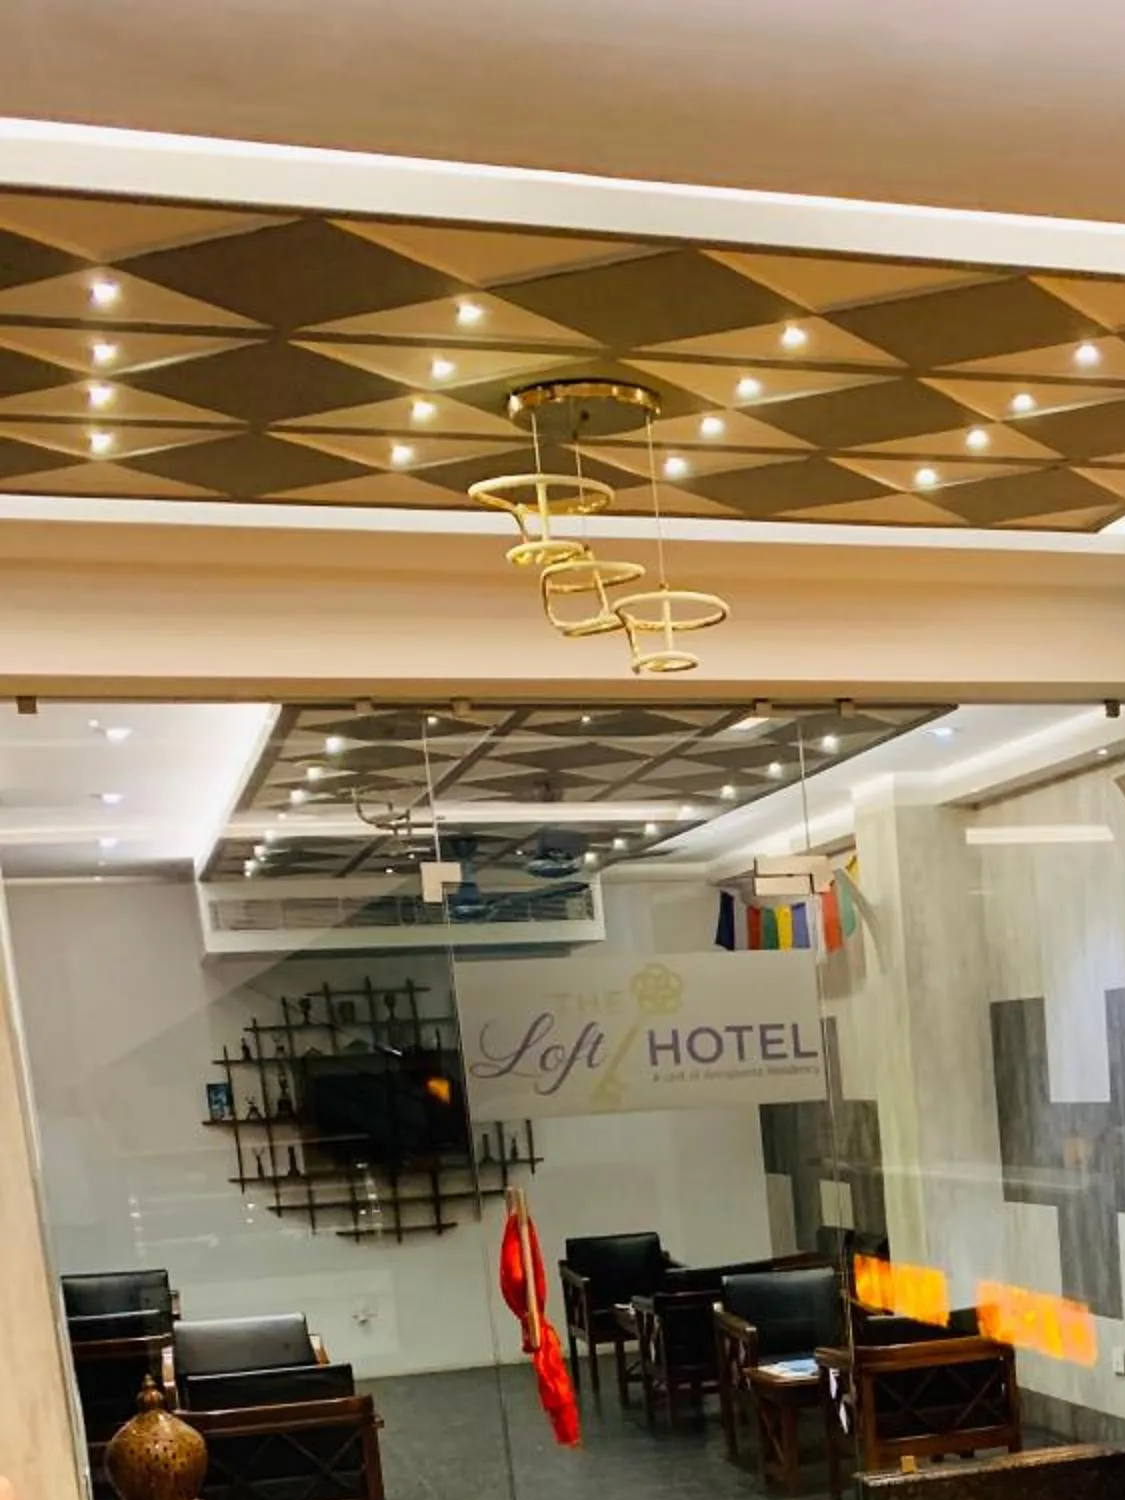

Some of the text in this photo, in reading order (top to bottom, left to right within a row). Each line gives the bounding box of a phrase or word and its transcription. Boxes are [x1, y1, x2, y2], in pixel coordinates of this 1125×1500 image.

[548, 990, 624, 1014] THE
[469, 1012, 818, 1096] Loft HOTEL
